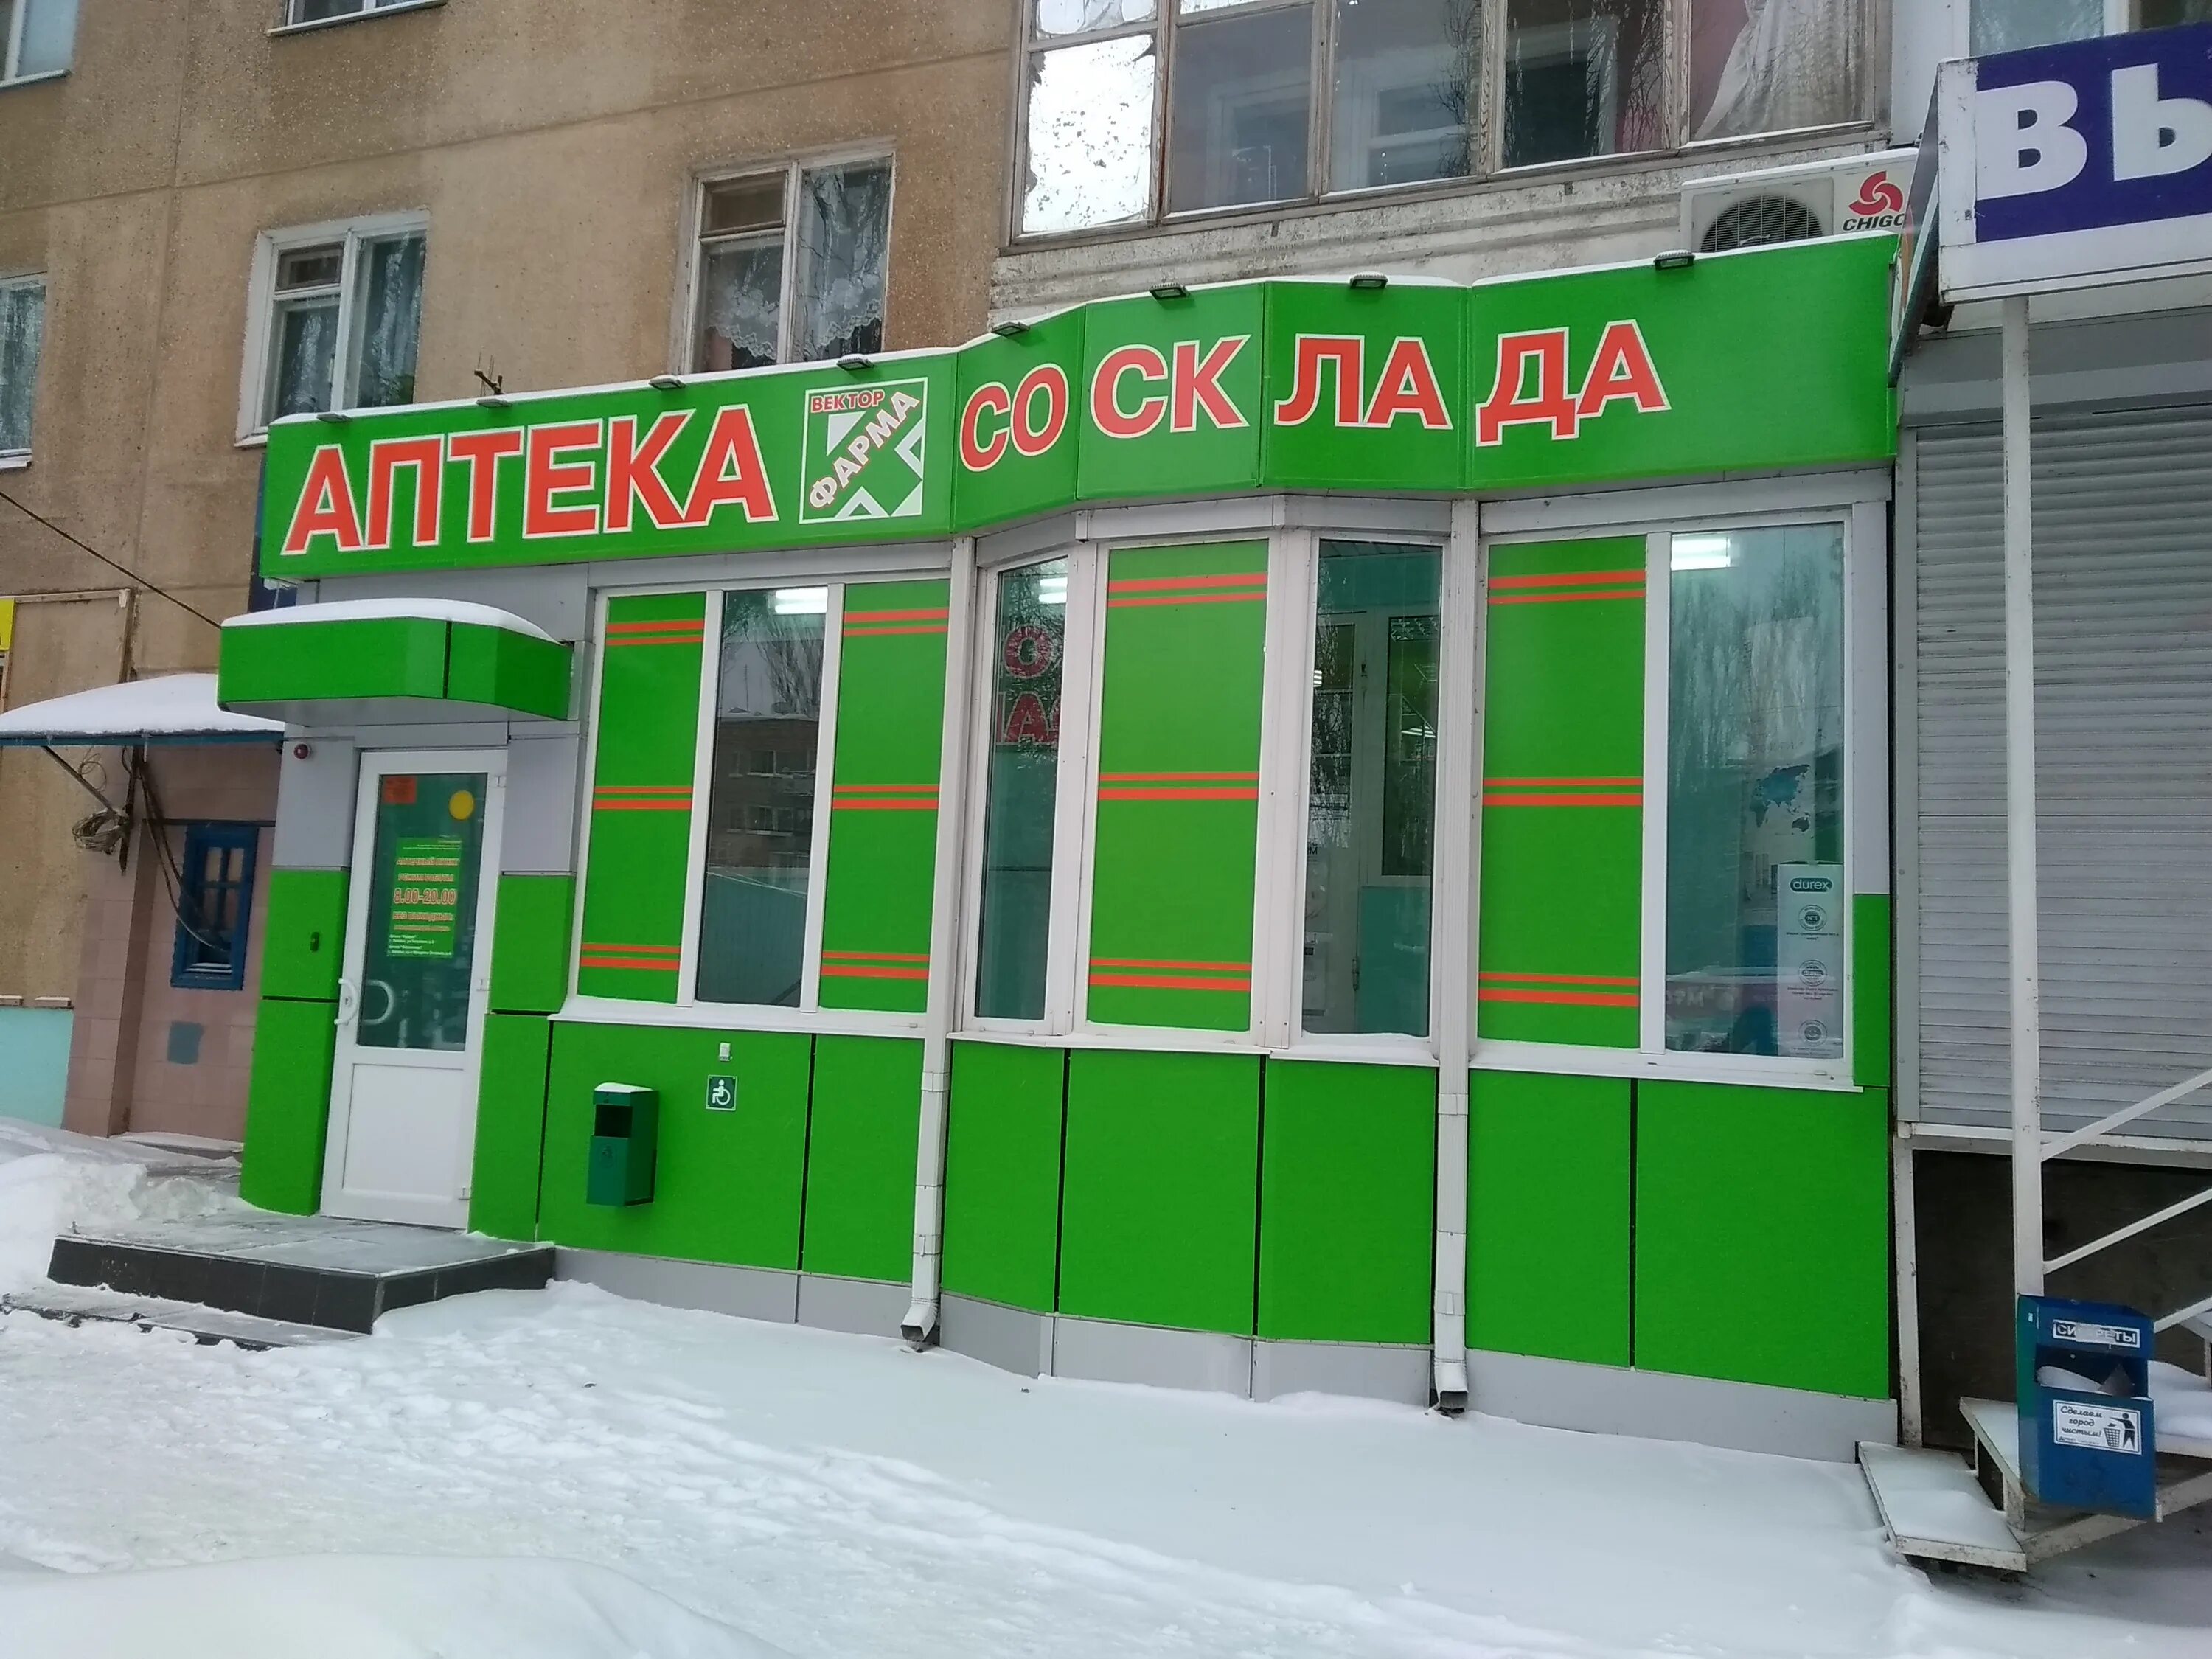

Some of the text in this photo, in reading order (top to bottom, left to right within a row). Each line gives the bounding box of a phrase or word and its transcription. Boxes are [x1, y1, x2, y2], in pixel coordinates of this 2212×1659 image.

[810, 389, 886, 414] ВЕКТОР
[810, 391, 921, 509] ФАРМА
[280, 403, 779, 556] АПТЕКА
[959, 361, 1071, 473] СО
[1792, 878, 1830, 891] durex
[393, 887, 457, 905] 8.00-20.00
[2060, 1405, 2103, 1418] Сделаем
[2069, 1418, 2095, 1427] город
[2062, 1427, 2102, 1437] чистым!
